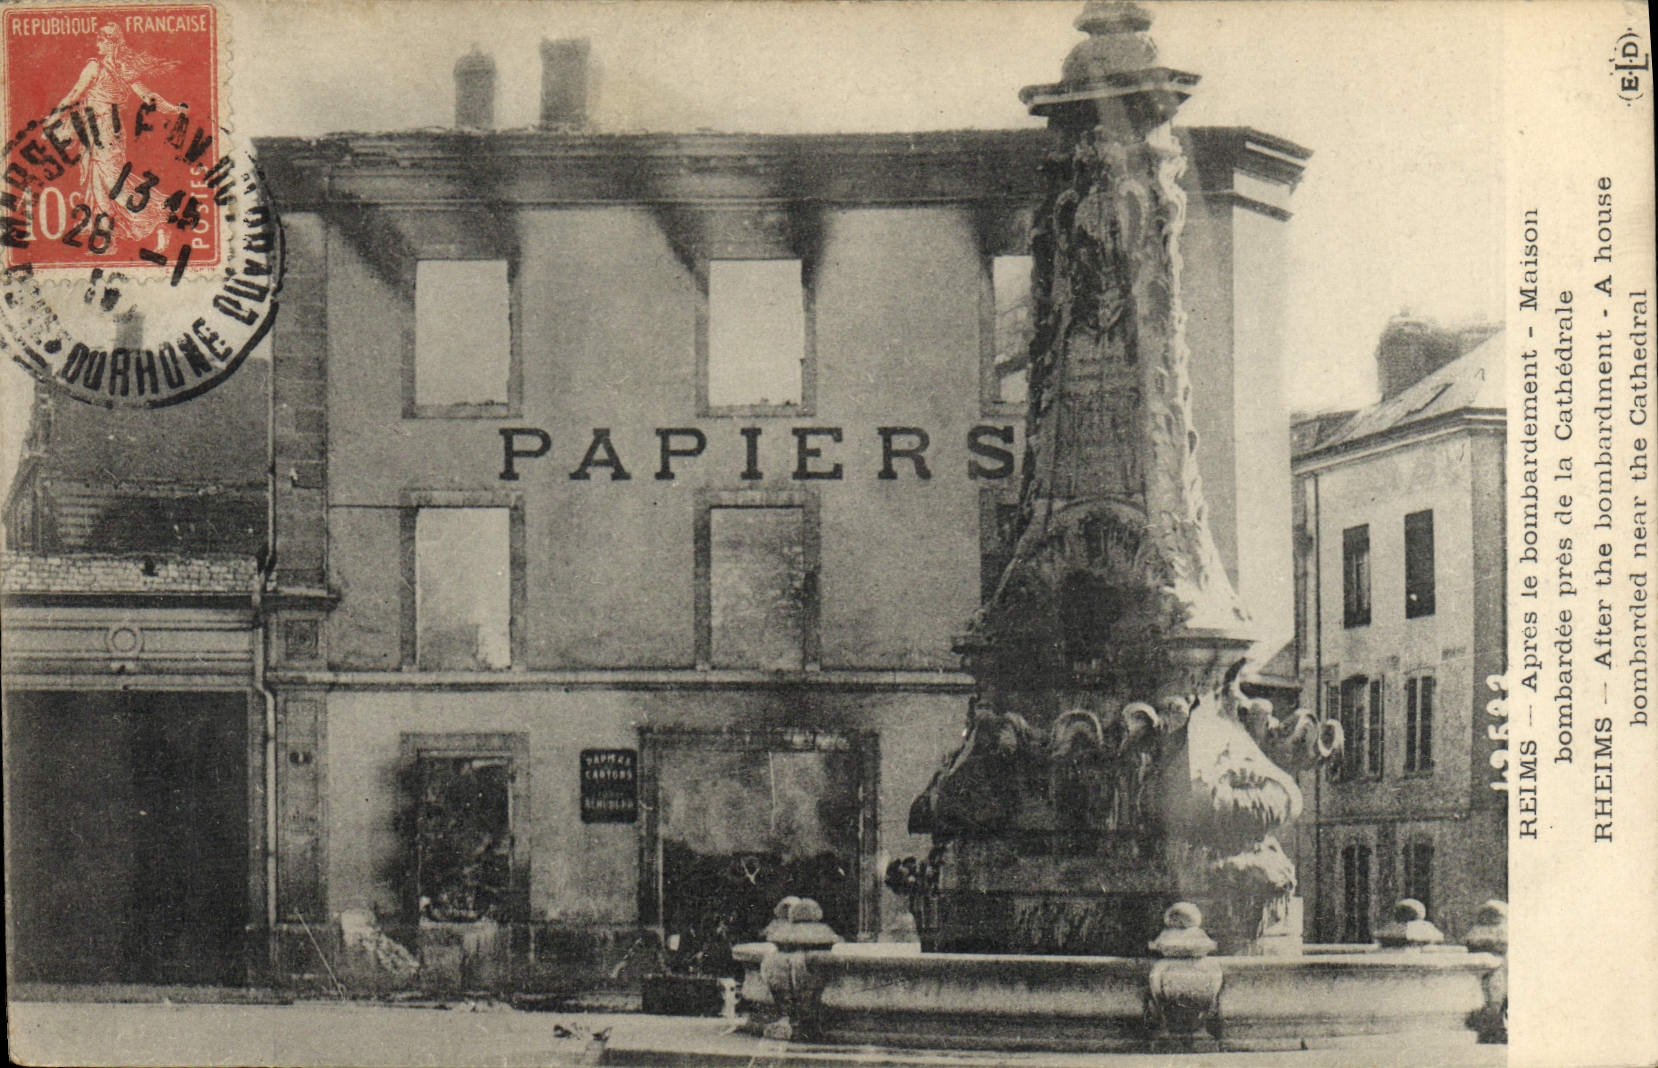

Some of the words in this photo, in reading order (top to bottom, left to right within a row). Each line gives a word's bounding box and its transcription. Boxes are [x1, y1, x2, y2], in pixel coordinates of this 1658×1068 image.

[125, 14, 207, 34] FRANÇAISE
[109, 161, 160, 213] 13
[189, 164, 211, 250] POSTES
[62, 204, 115, 255] 28
[499, 426, 1016, 482] PAPIERS
